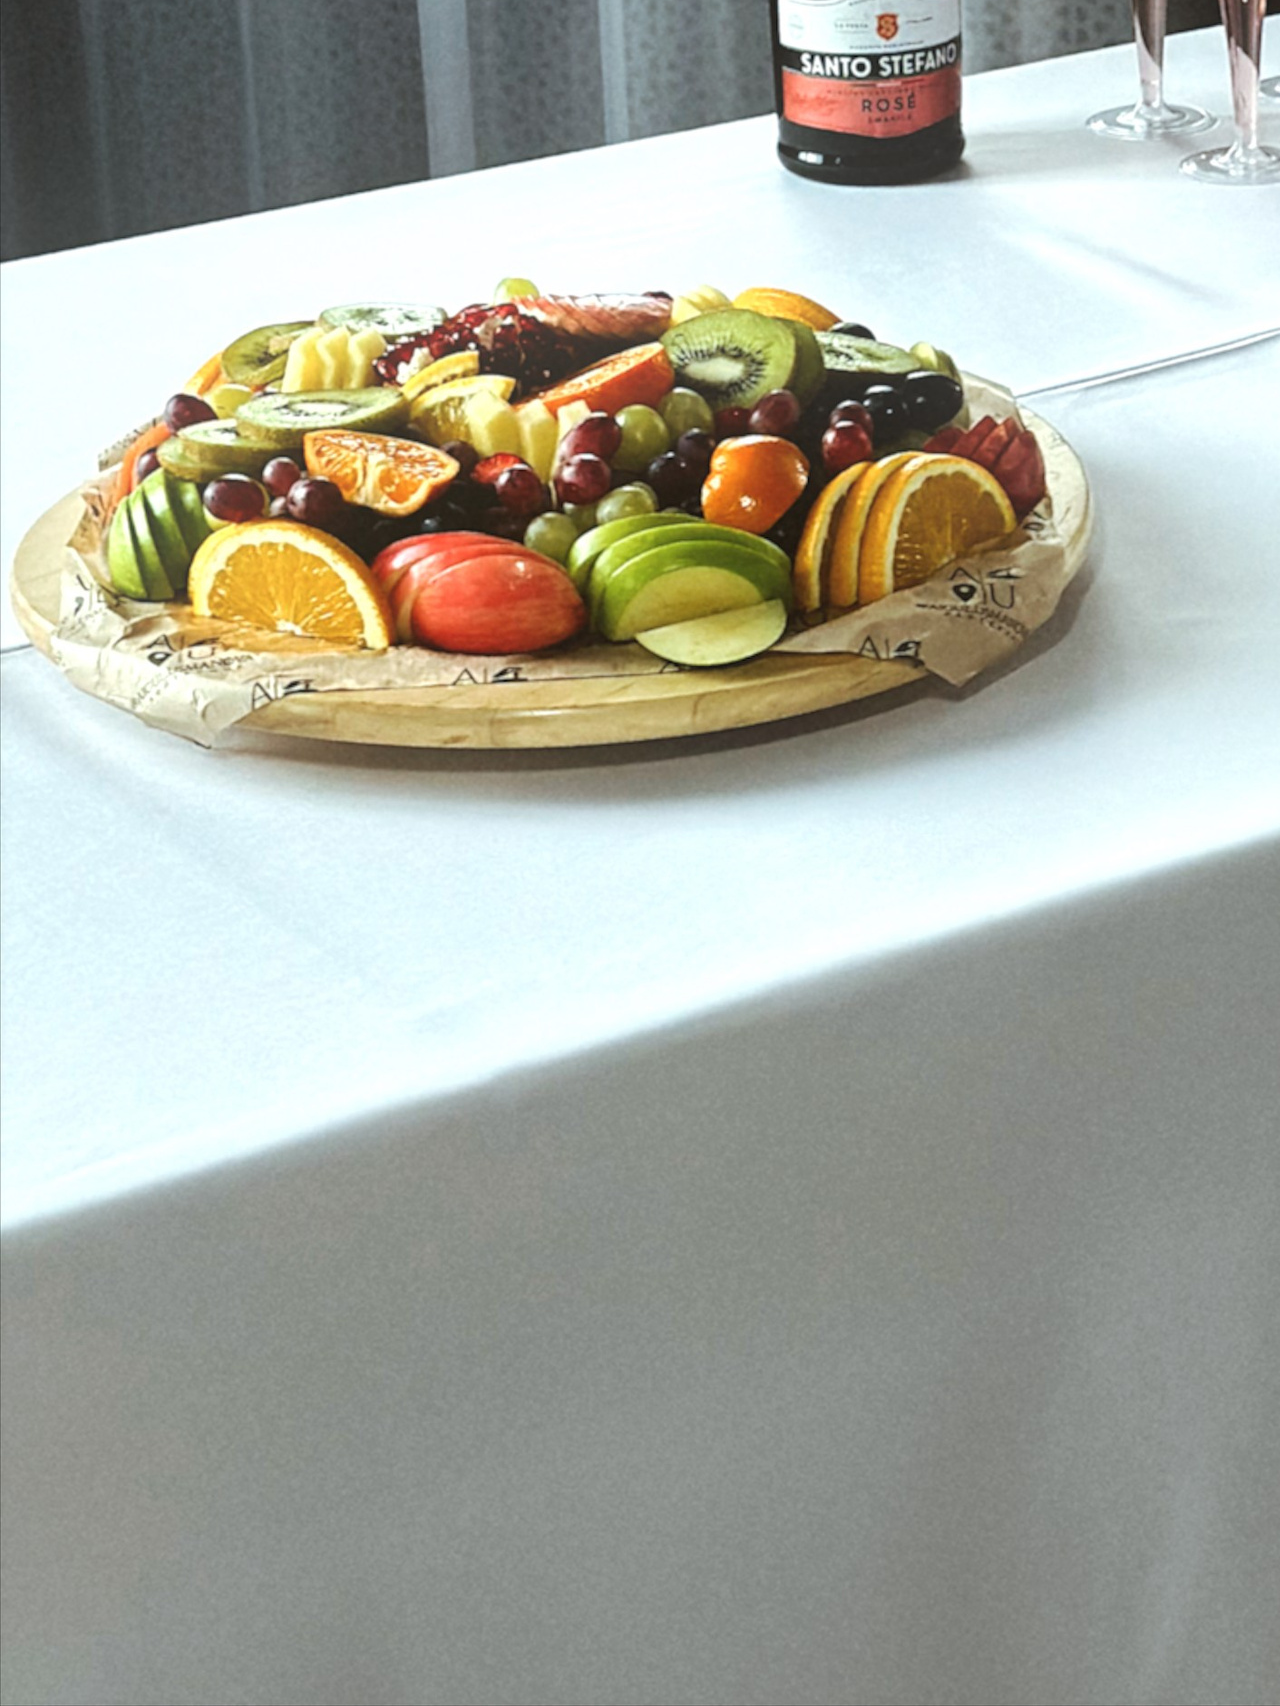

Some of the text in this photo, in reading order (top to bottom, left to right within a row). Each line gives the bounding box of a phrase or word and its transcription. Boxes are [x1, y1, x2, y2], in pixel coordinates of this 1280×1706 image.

[801, 42, 957, 78] SANTO STEFANO
[861, 91, 916, 113] ROSÉ
